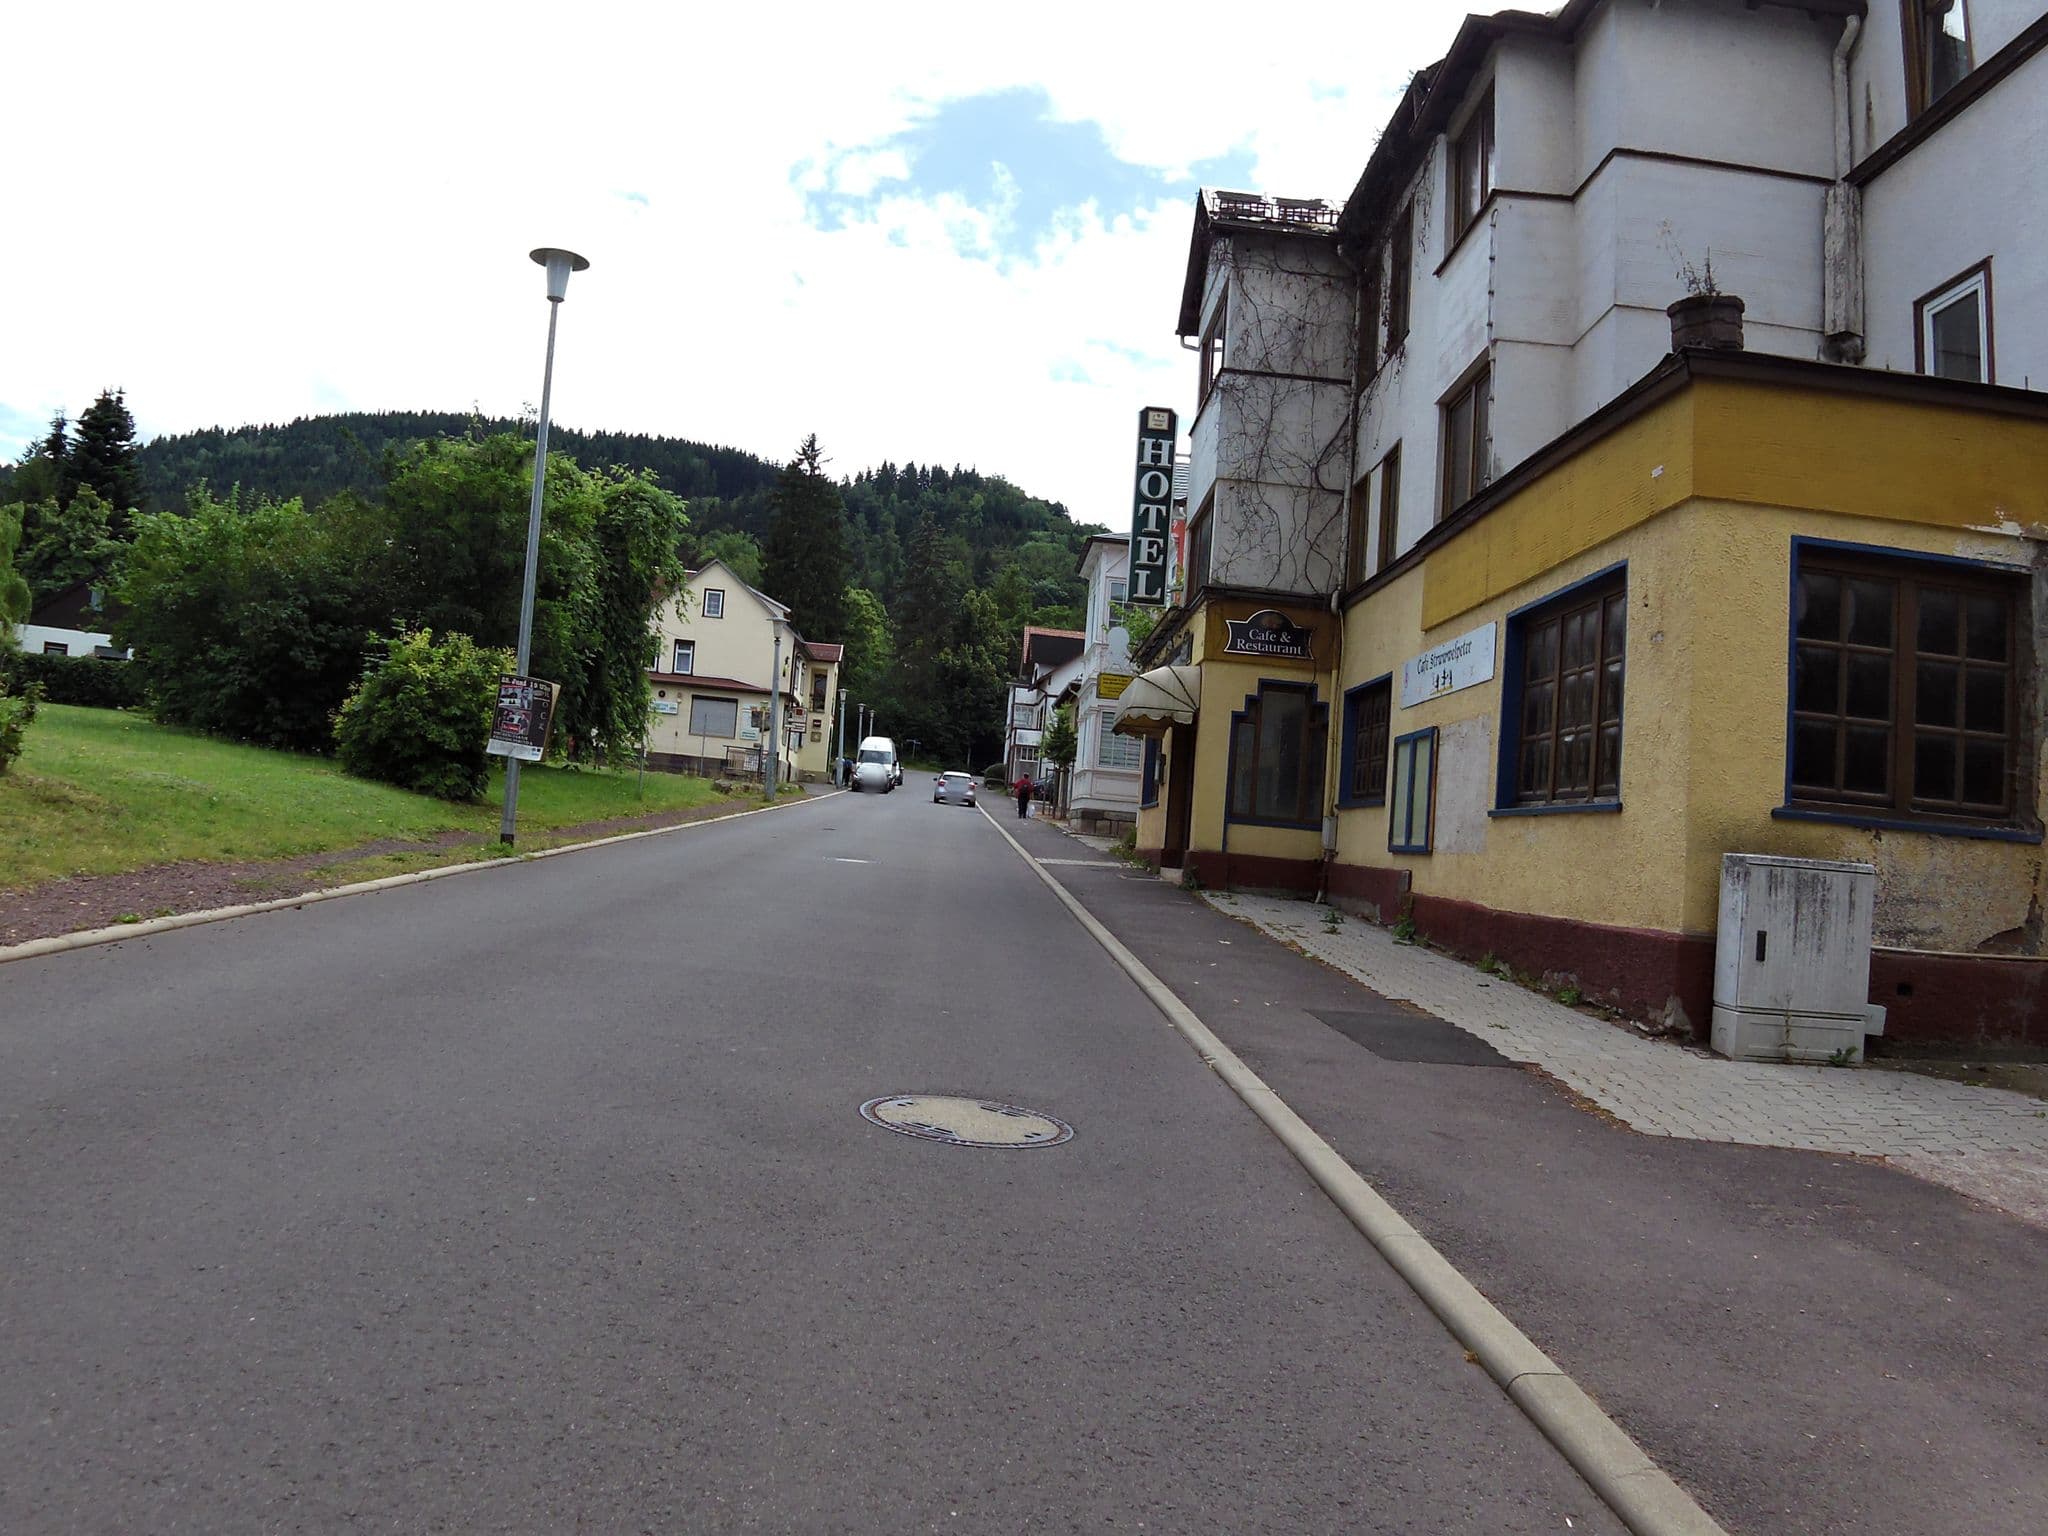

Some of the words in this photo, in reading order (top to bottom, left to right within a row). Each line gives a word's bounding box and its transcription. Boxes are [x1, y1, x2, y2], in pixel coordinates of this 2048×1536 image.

[1133, 437, 1173, 600] HOTEL
[1280, 631, 1291, 643] &
[1237, 639, 1302, 655] Restaurant
